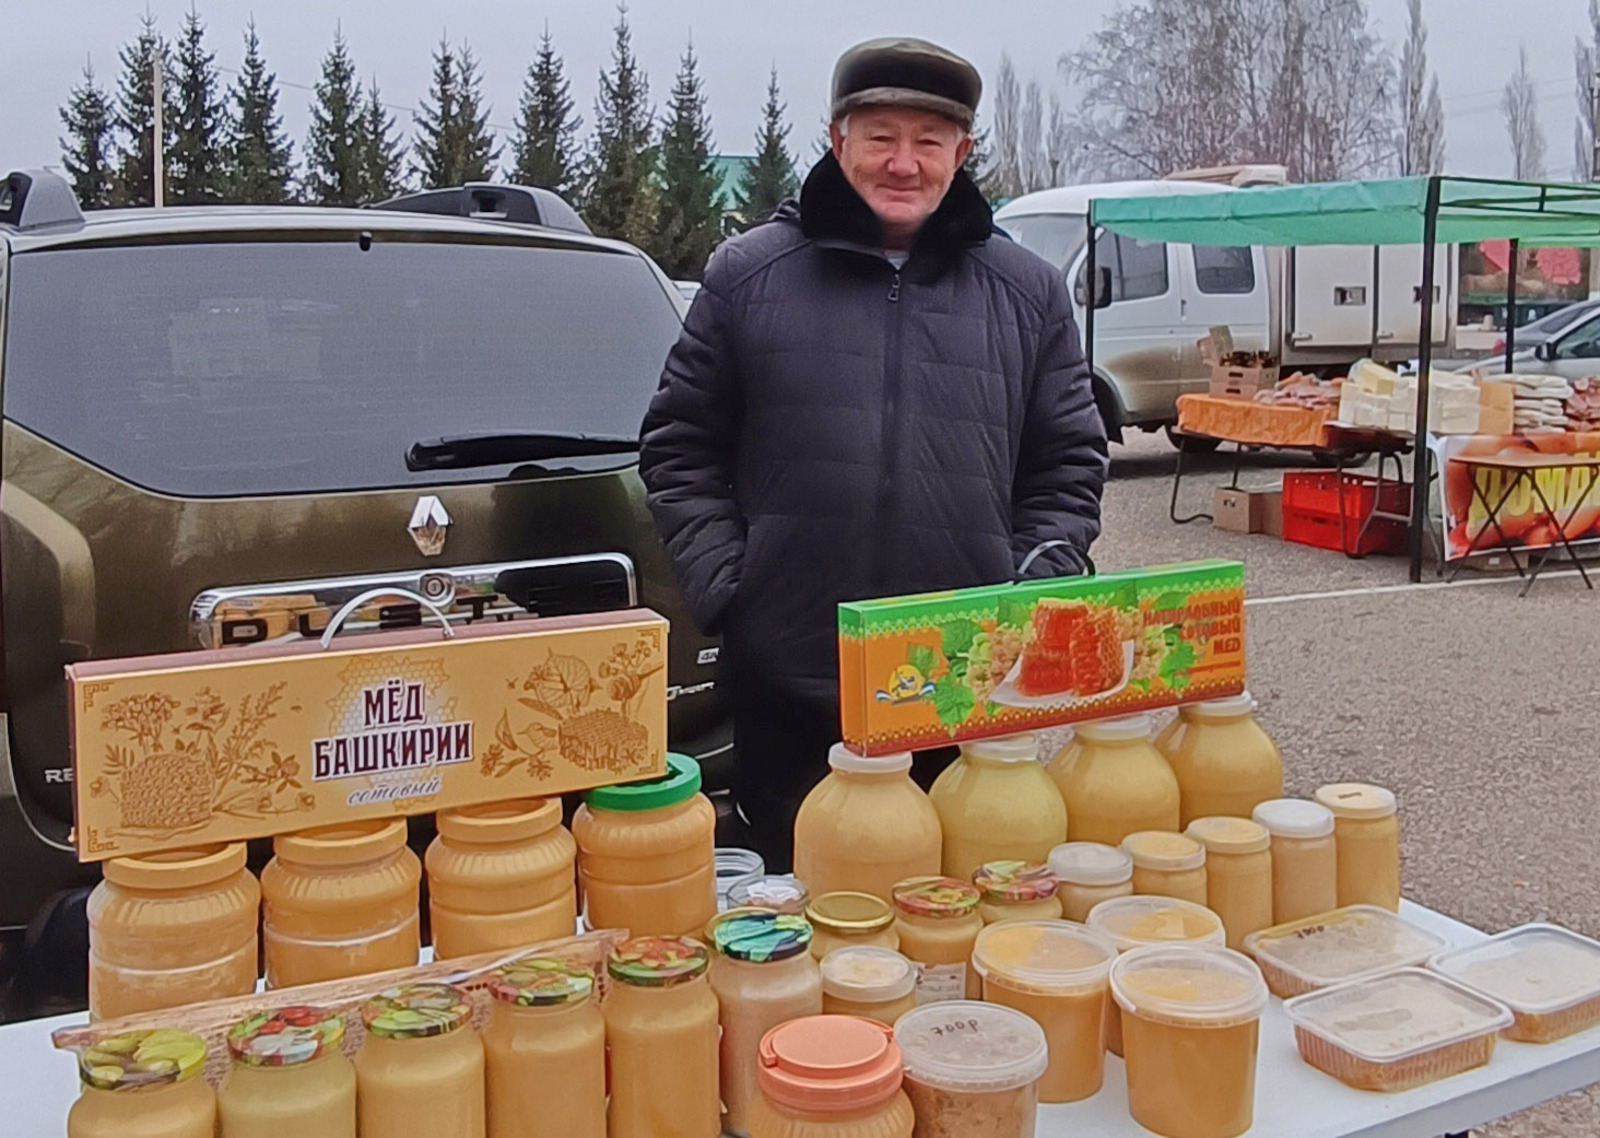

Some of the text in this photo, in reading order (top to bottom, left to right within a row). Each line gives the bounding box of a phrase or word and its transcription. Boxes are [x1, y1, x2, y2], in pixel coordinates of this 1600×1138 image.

[1468, 453, 1600, 527] ДОМА
[221, 594, 517, 645] DUST
[364, 680, 423, 726] МЁД
[314, 723, 471, 778] БАШКИРИИ
[348, 776, 441, 805] сотовый
